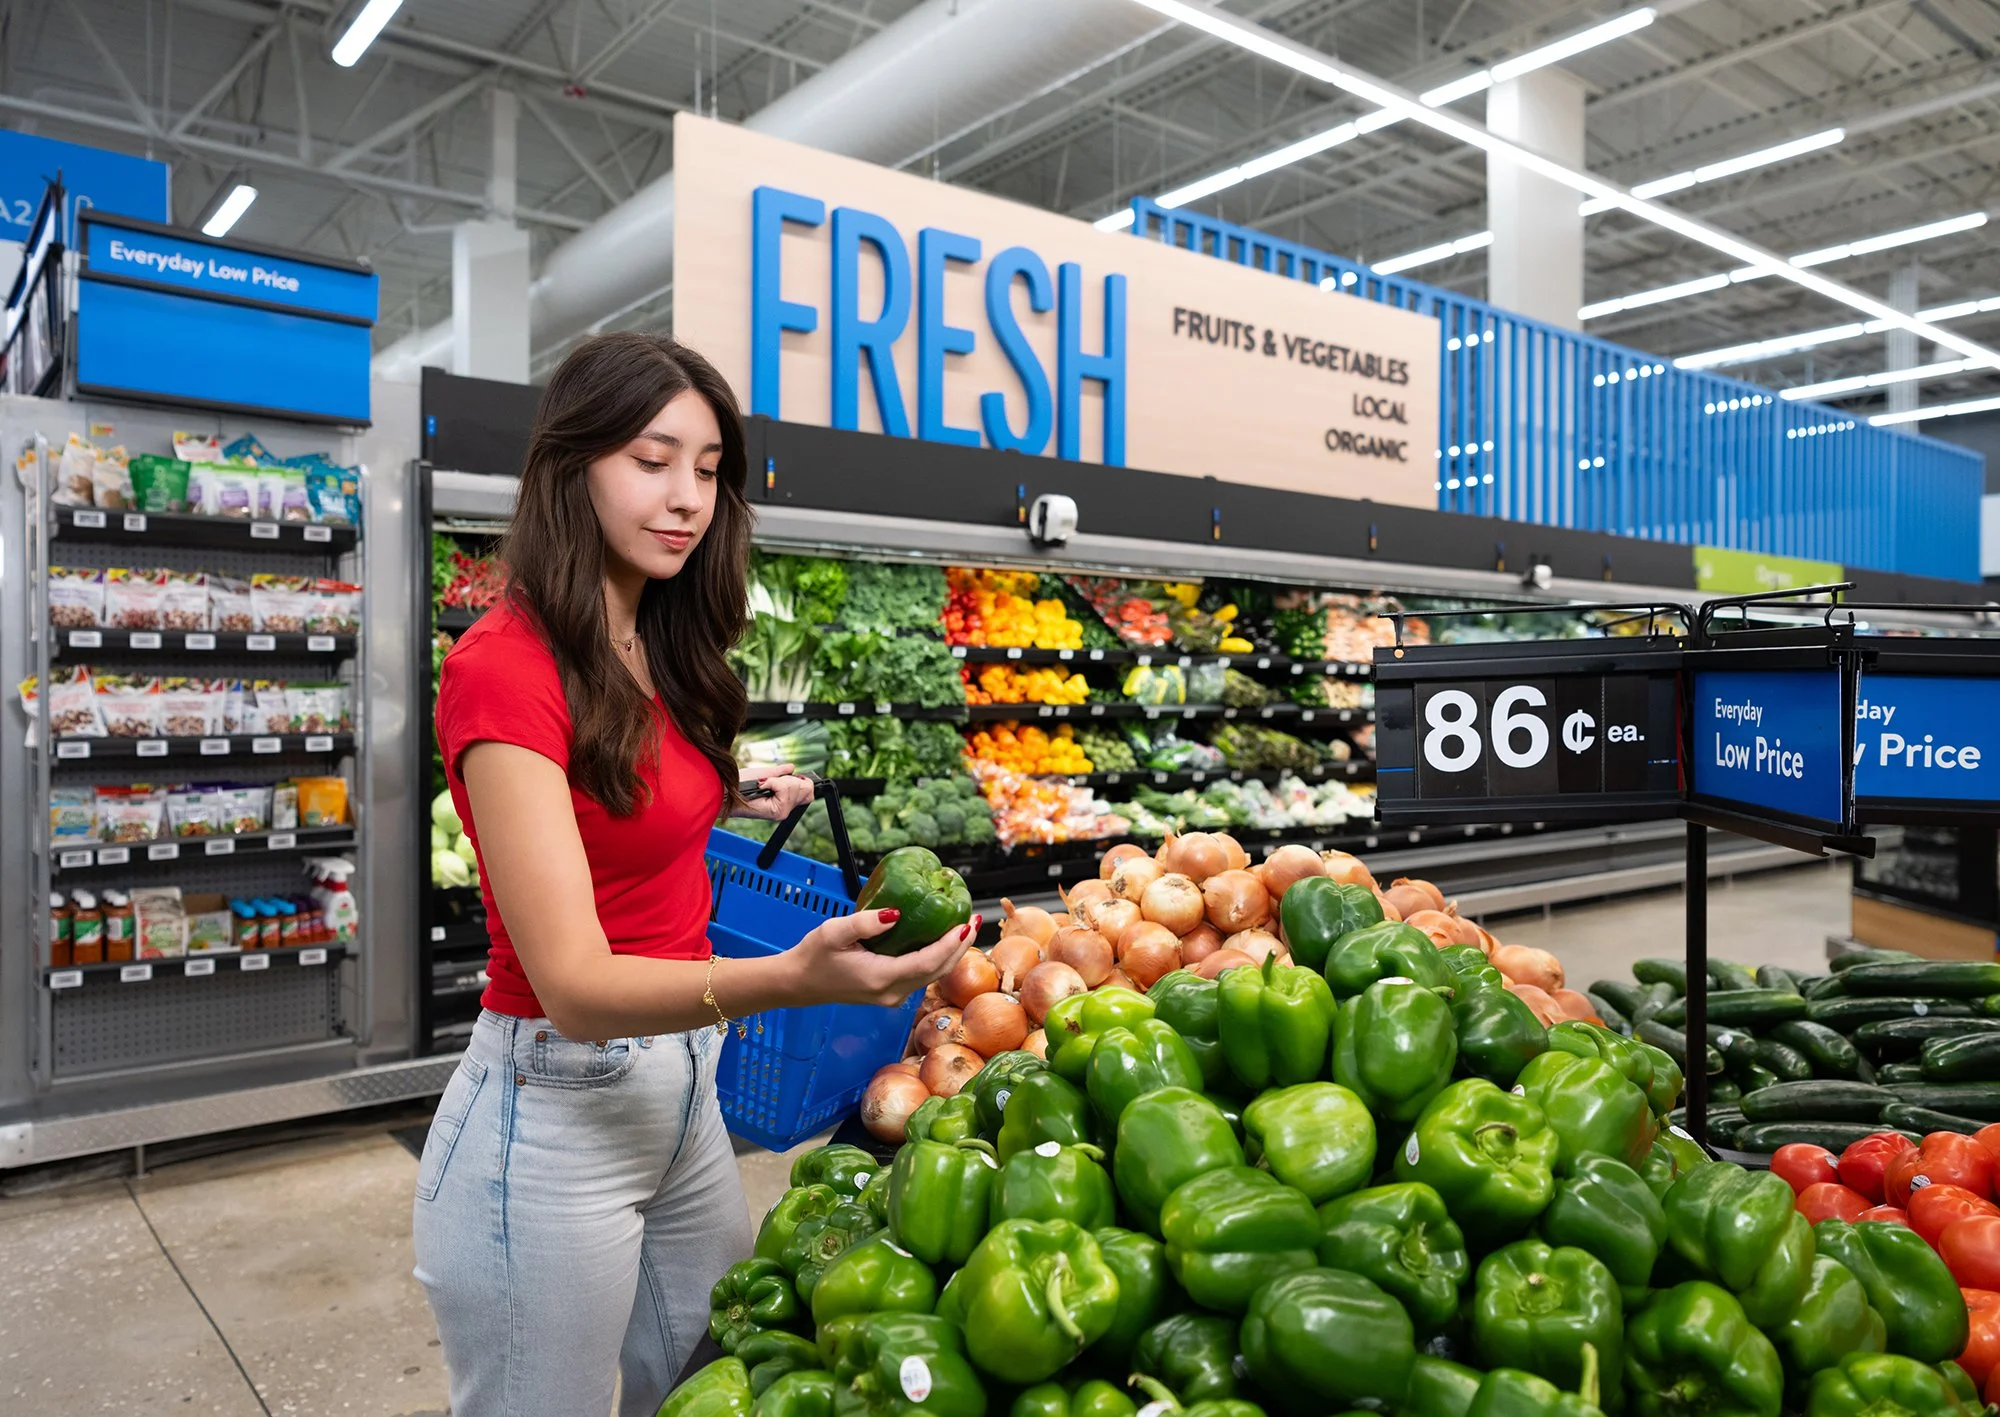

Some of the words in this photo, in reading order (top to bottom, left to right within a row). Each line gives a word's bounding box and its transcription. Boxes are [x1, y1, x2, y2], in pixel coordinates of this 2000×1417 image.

[110, 240, 204, 279] Everyday
[208, 258, 248, 283] Low
[252, 266, 300, 292] Price
[751, 185, 1127, 467] FRESH
[1173, 306, 1256, 353] FRUITS
[1262, 329, 1278, 357] &
[1283, 333, 1410, 386] VEGETABLES
[1353, 394, 1409, 425] LOCAL
[1325, 428, 1409, 463] ORGANIC
[1715, 697, 1763, 728] Everyday
[1606, 724, 1646, 743] ea.
[1879, 733, 1982, 770] Price
[1716, 731, 1751, 771] Low
[1755, 736, 1804, 779] Price
